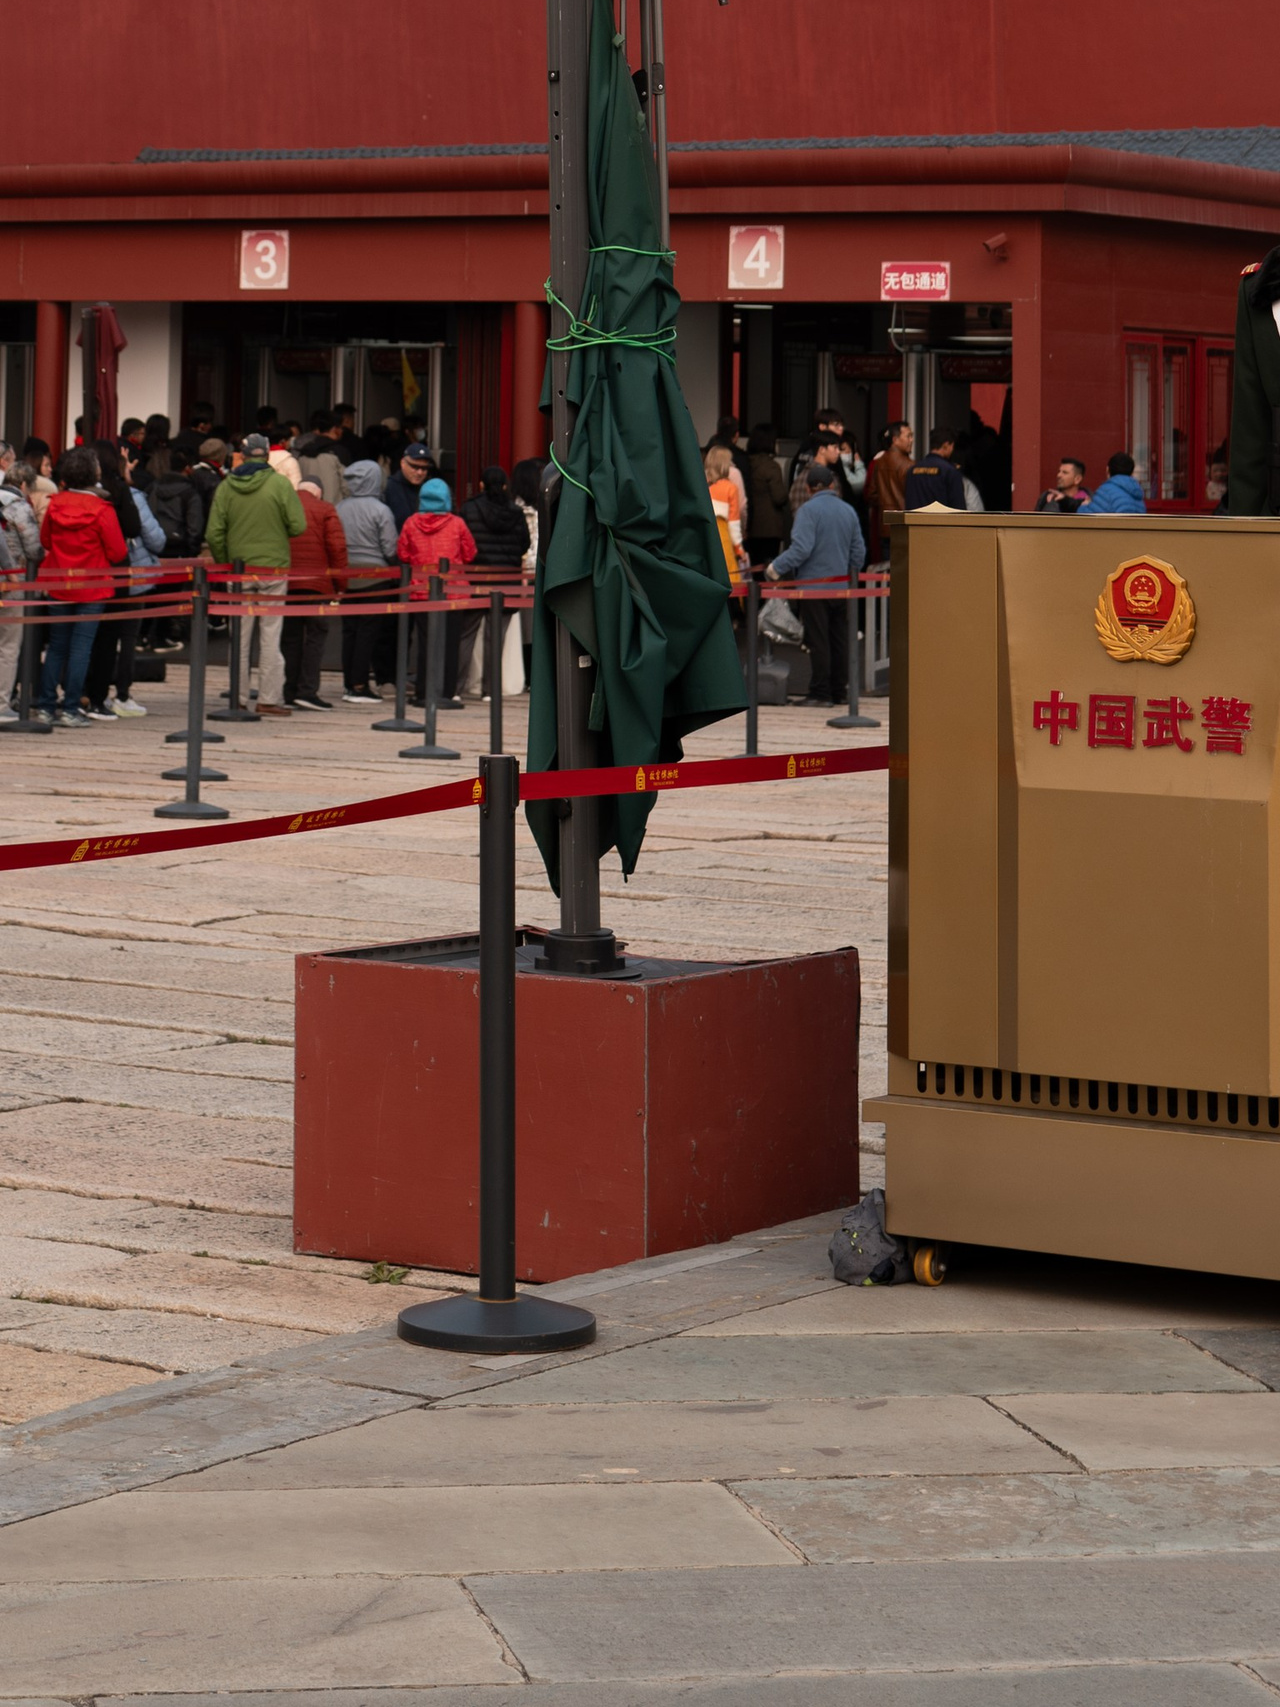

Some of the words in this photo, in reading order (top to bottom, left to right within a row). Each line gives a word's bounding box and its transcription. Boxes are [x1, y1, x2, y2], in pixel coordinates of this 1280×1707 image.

[254, 239, 277, 280] 3
[743, 235, 770, 278] 4
[884, 272, 947, 291] 无包通道
[1033, 690, 1252, 755] 中国武警
